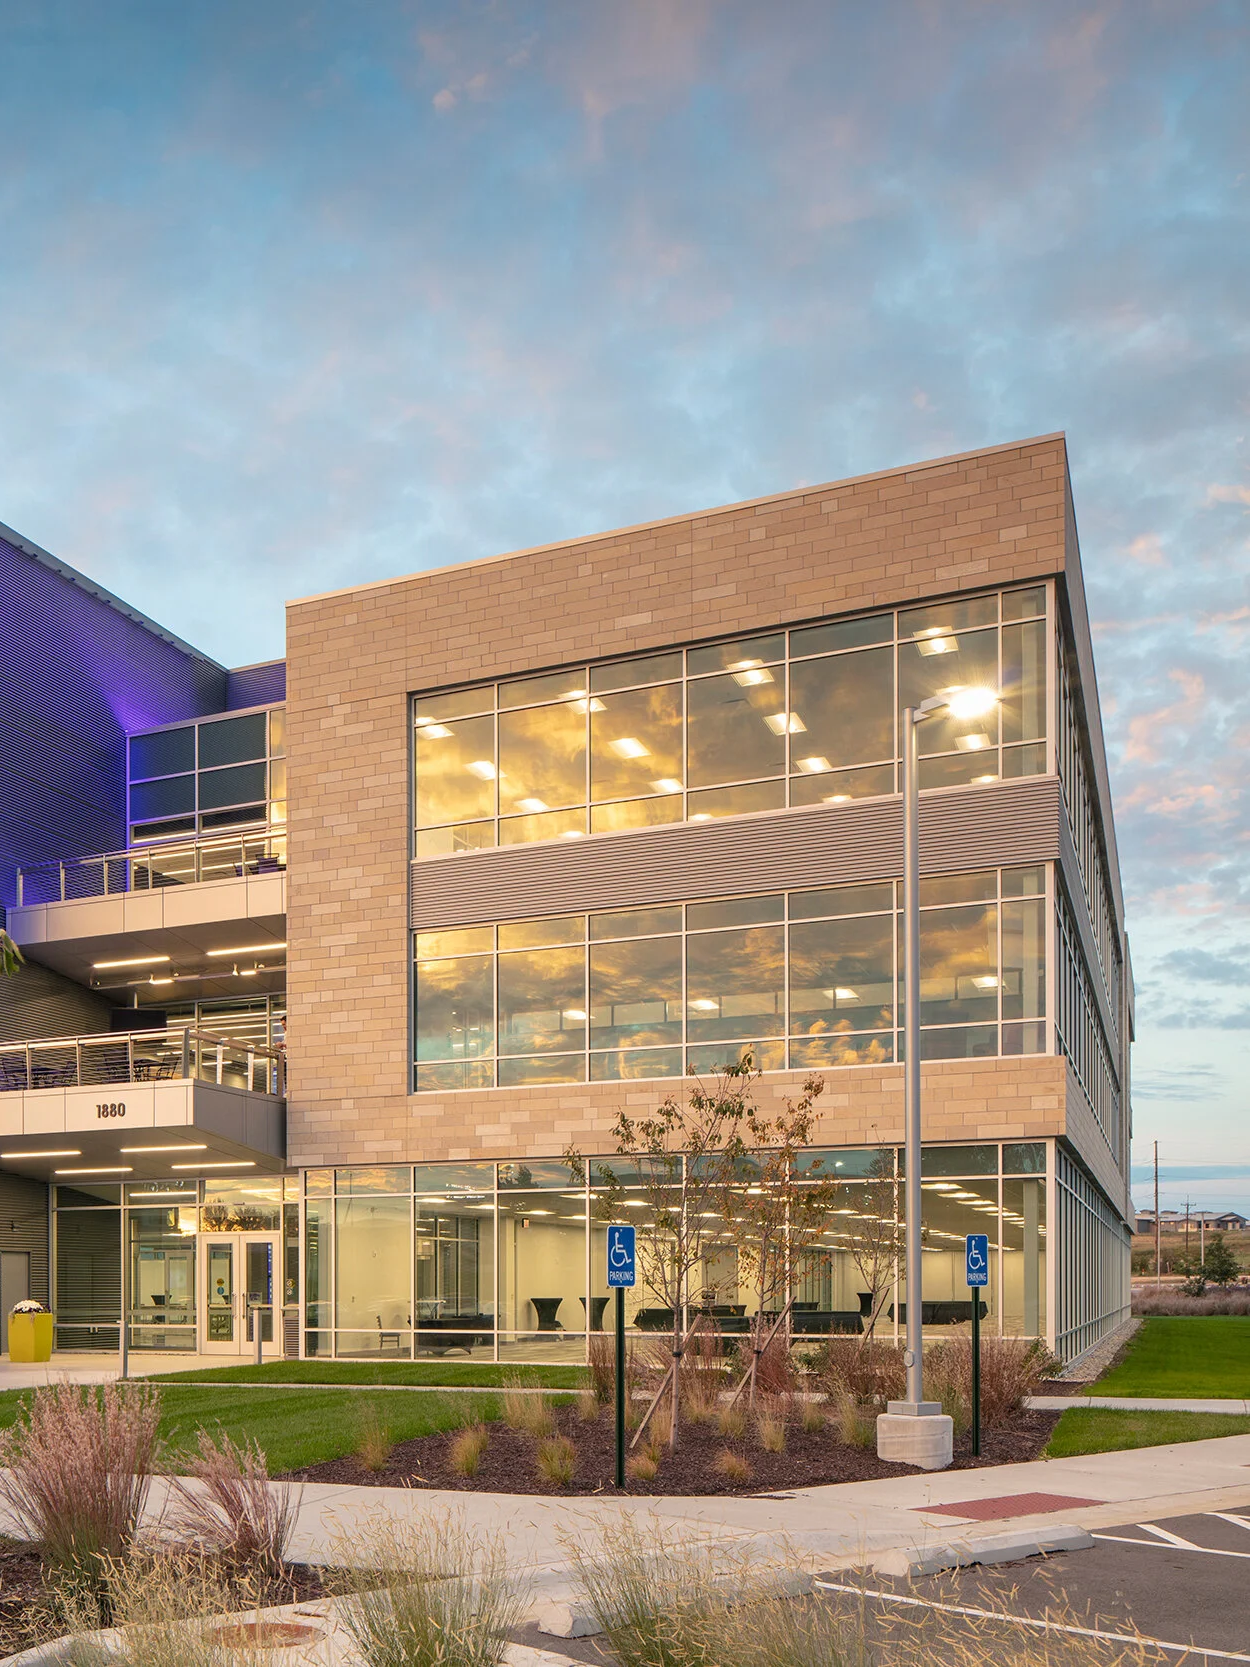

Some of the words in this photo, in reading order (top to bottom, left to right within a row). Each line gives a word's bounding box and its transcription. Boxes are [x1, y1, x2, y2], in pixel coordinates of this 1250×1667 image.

[95, 1102, 126, 1119] 1880
[609, 1270, 634, 1281] PARKING
[967, 1271, 987, 1282] PARKING
